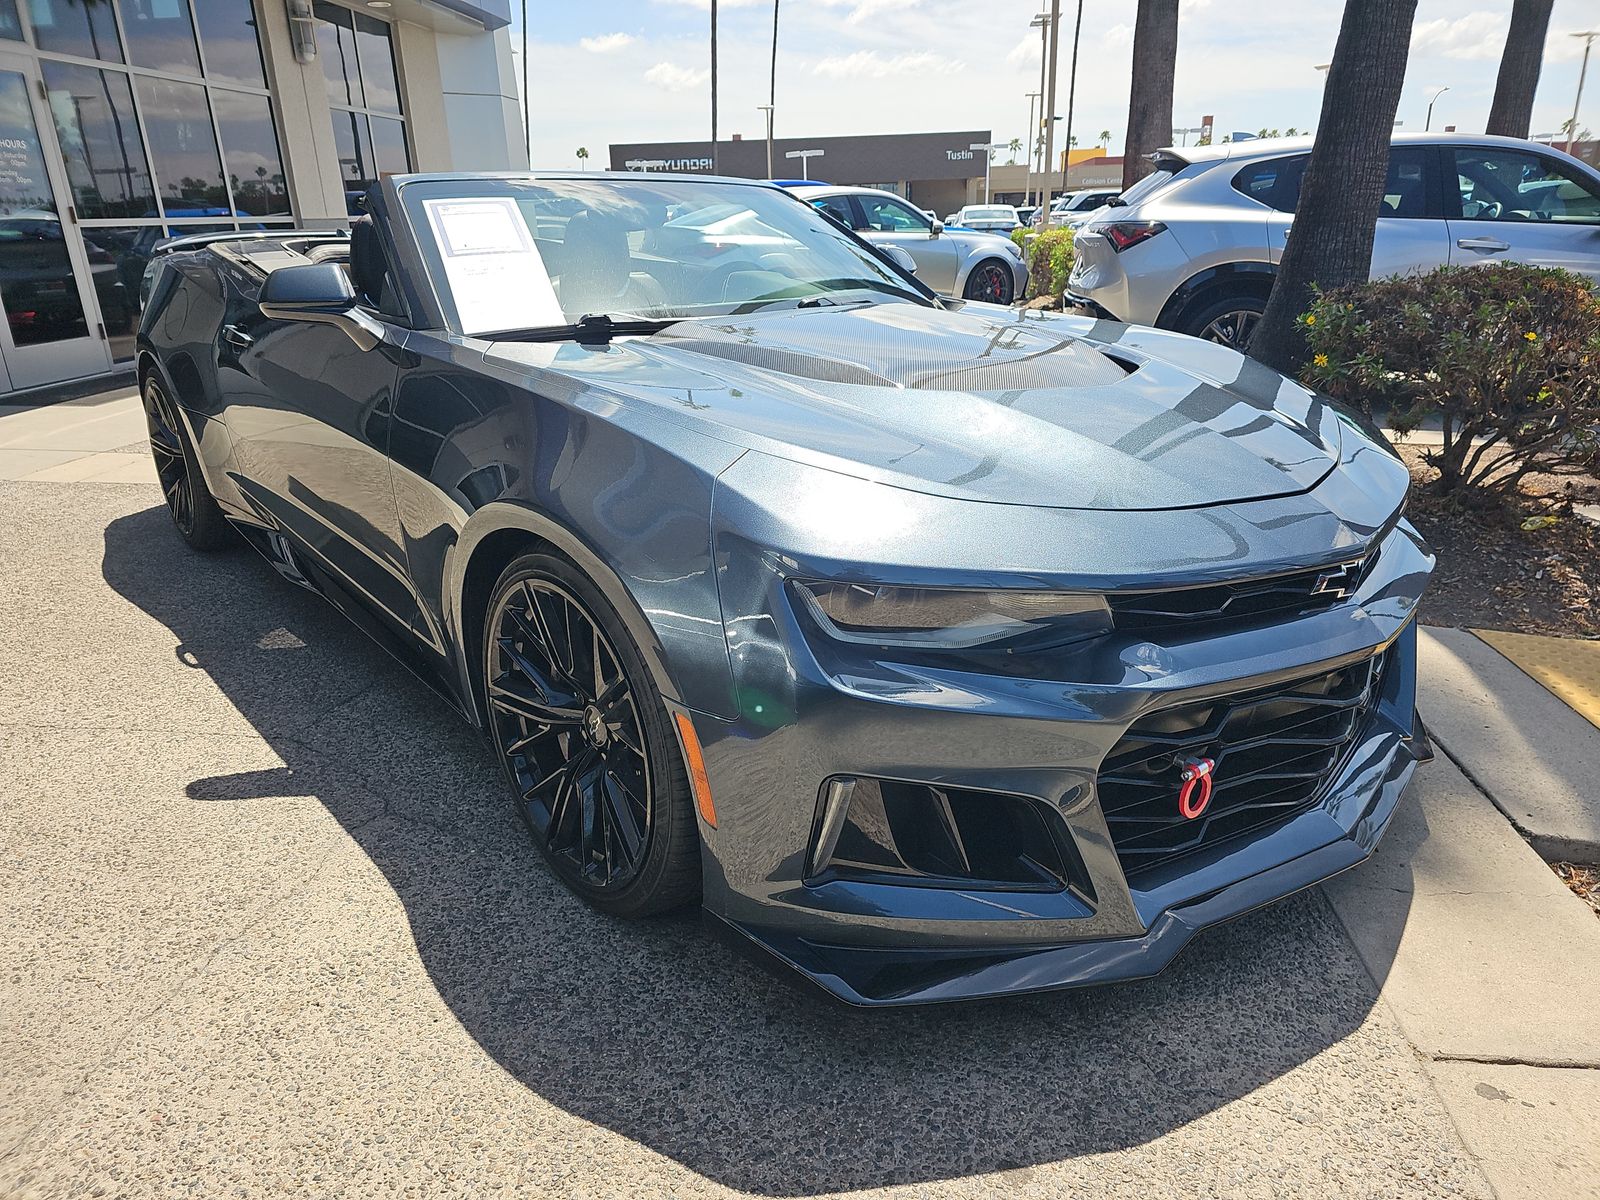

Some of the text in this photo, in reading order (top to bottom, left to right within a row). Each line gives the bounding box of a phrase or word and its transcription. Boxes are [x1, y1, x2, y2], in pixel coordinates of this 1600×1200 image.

[0, 139, 26, 149] HOURS
[946, 150, 973, 160] Tustin
[1081, 177, 1105, 185] Collision
